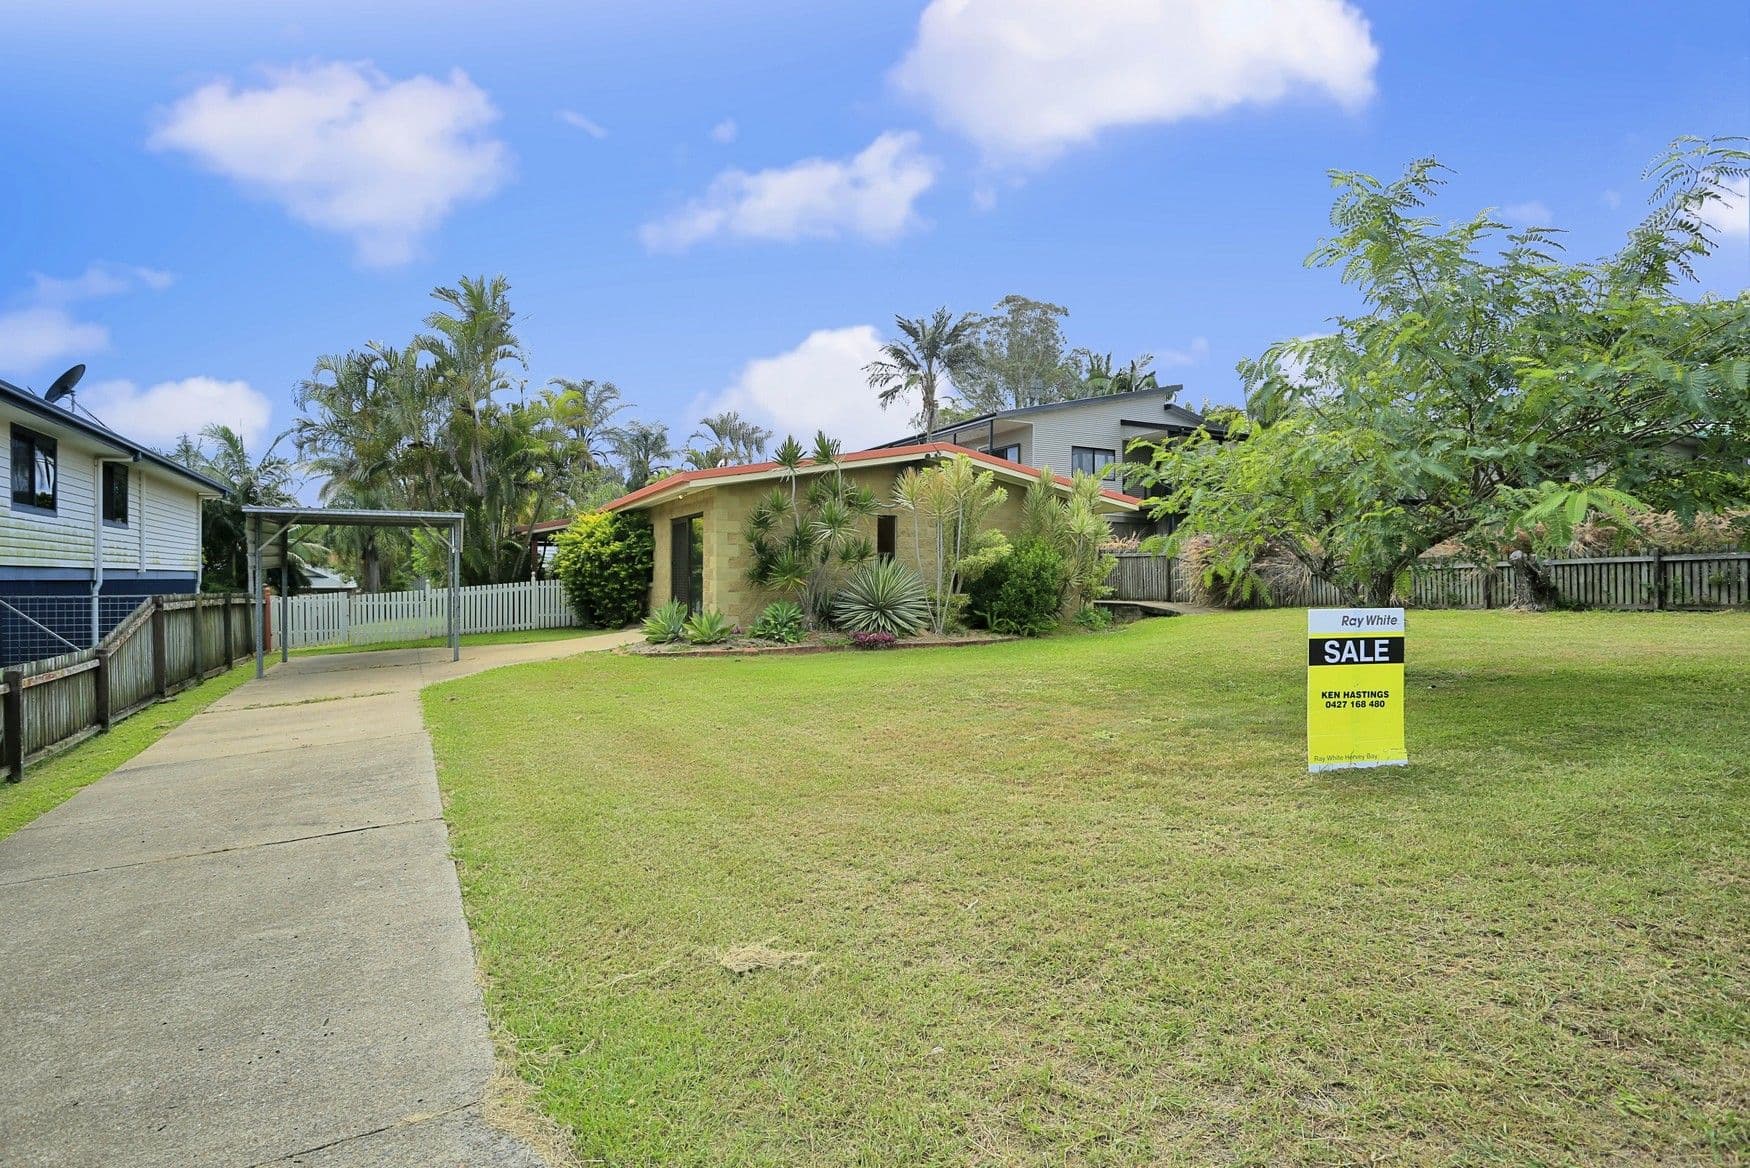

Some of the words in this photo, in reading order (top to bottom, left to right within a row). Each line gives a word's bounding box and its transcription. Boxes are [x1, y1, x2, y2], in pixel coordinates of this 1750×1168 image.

[1341, 615, 1365, 628] Ray
[1366, 614, 1398, 626] White
[1324, 639, 1390, 664] SALE
[1321, 691, 1341, 699] KEN
[1343, 690, 1389, 699] HASTINGS
[1350, 700, 1366, 708] 168
[1369, 700, 1385, 708] 480
